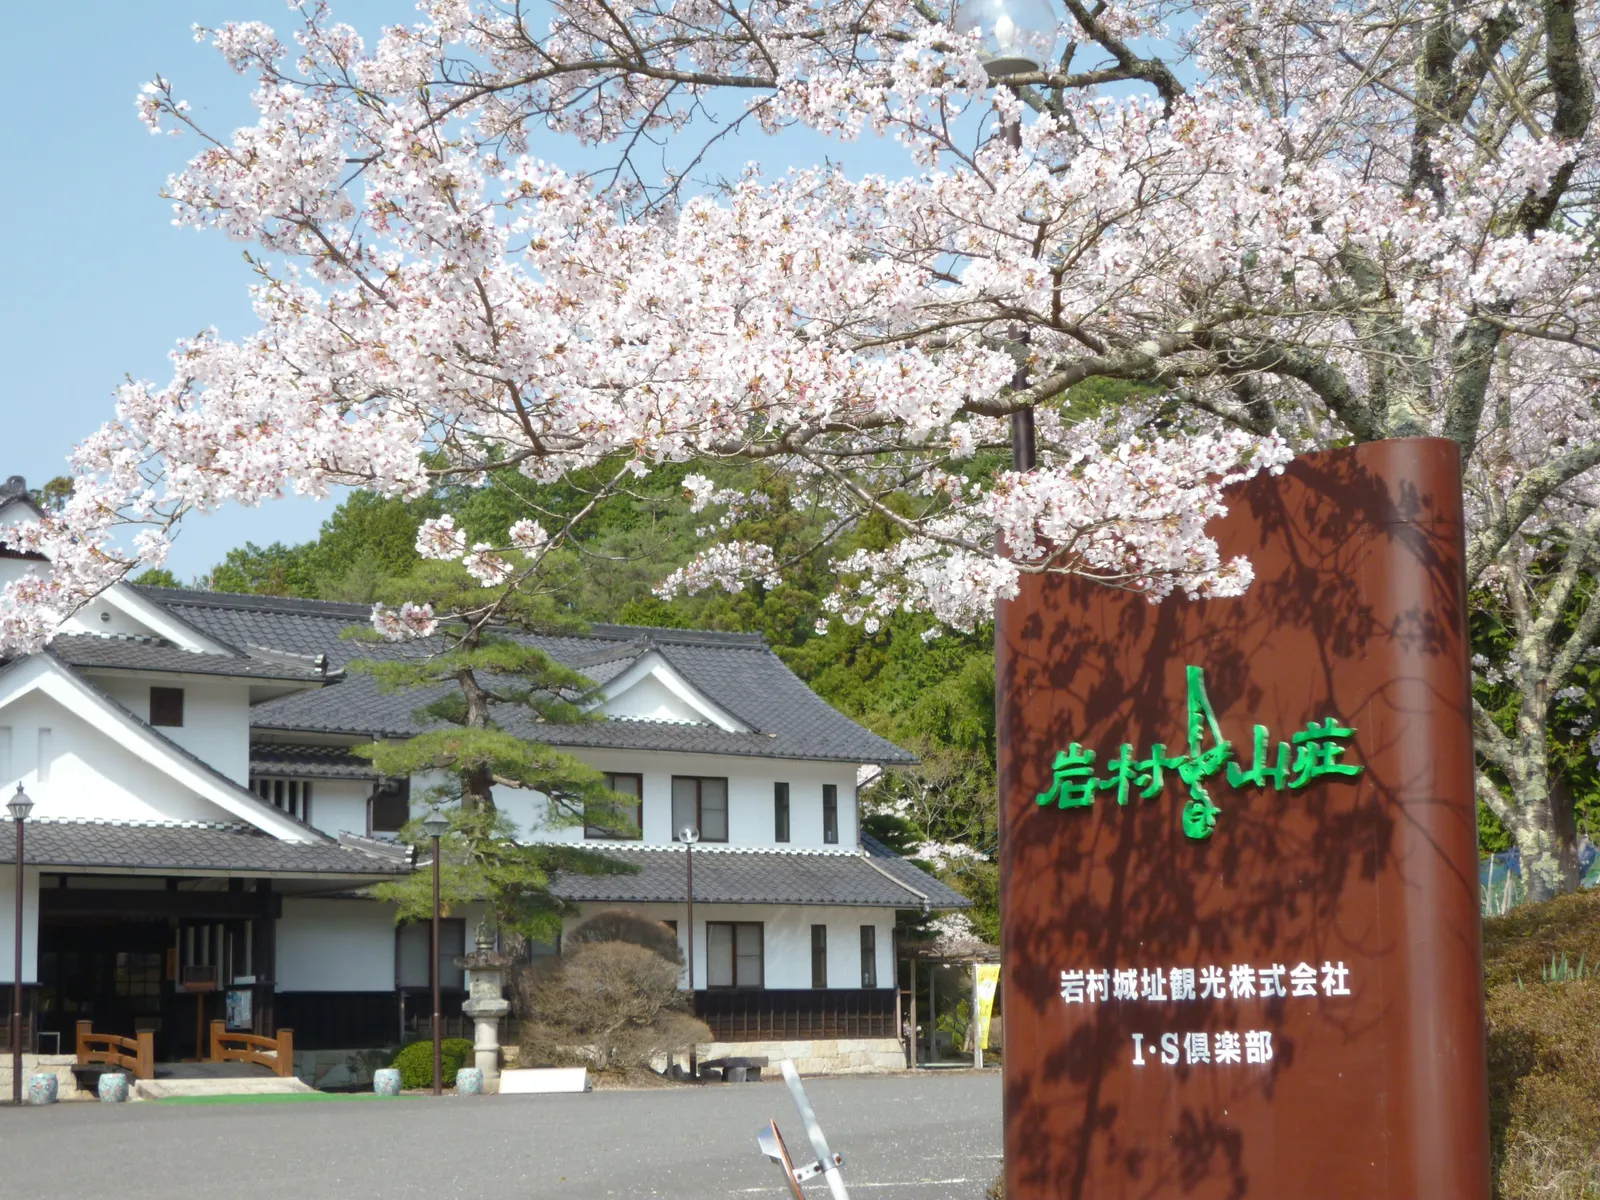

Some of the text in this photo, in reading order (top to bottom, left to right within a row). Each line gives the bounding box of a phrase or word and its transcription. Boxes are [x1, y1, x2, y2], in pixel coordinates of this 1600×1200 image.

[1060, 960, 1351, 1004] 岩村城址観光株式会社
